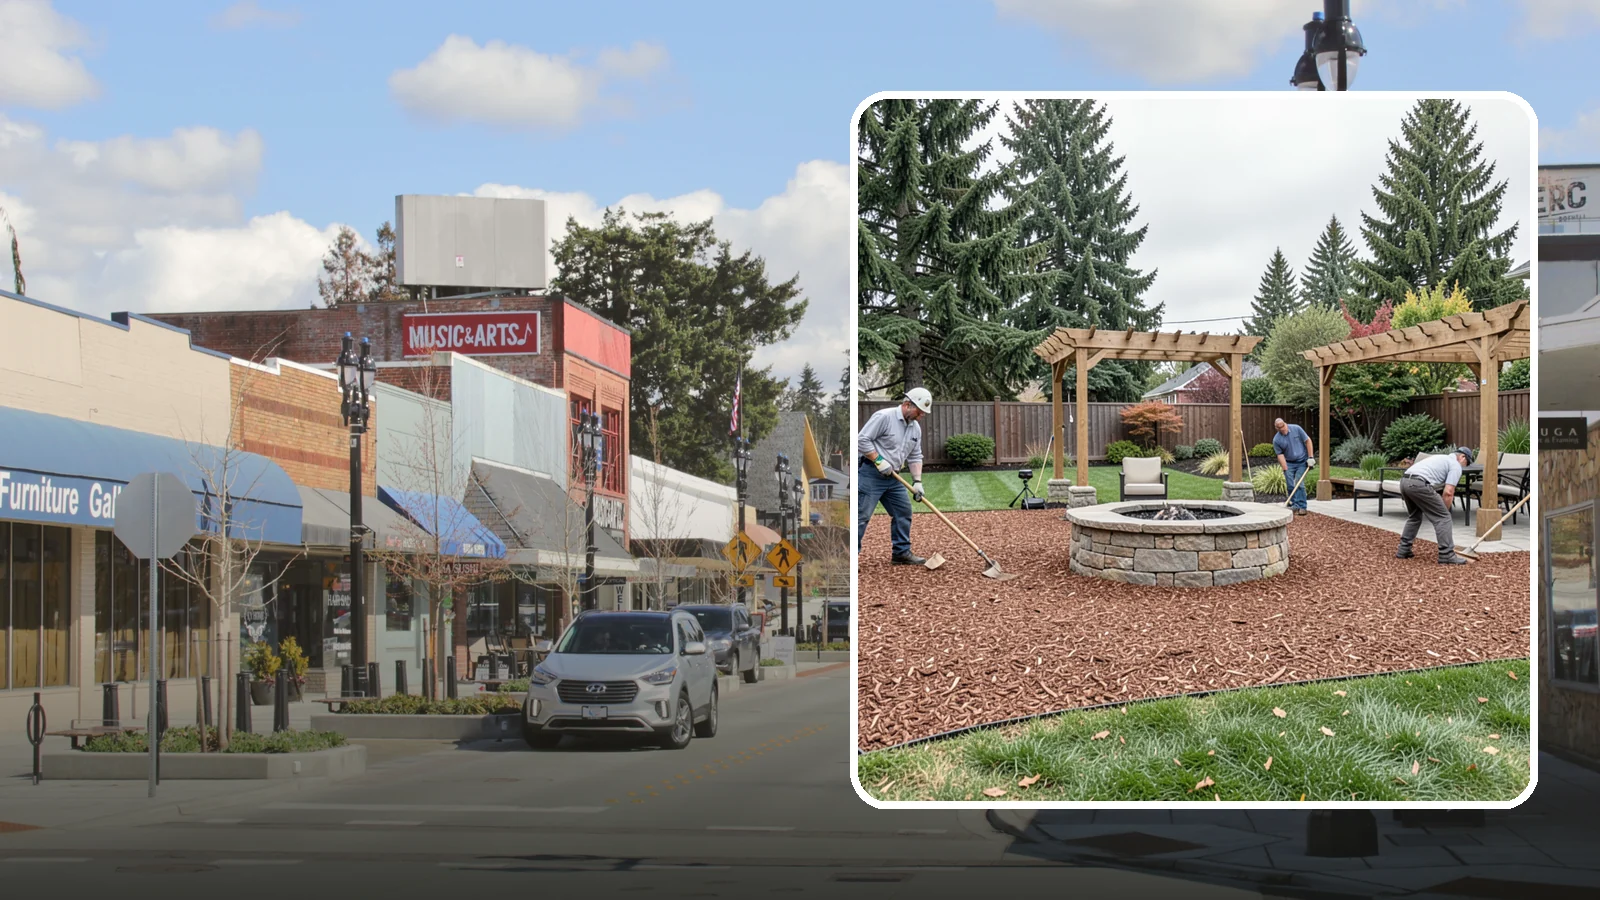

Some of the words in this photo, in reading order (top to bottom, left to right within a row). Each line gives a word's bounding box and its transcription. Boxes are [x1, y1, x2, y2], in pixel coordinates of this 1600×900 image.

[408, 323, 520, 349] MUSIC&ARTS
[0, 471, 80, 516] Furniture
[89, 482, 122, 519] Gal
